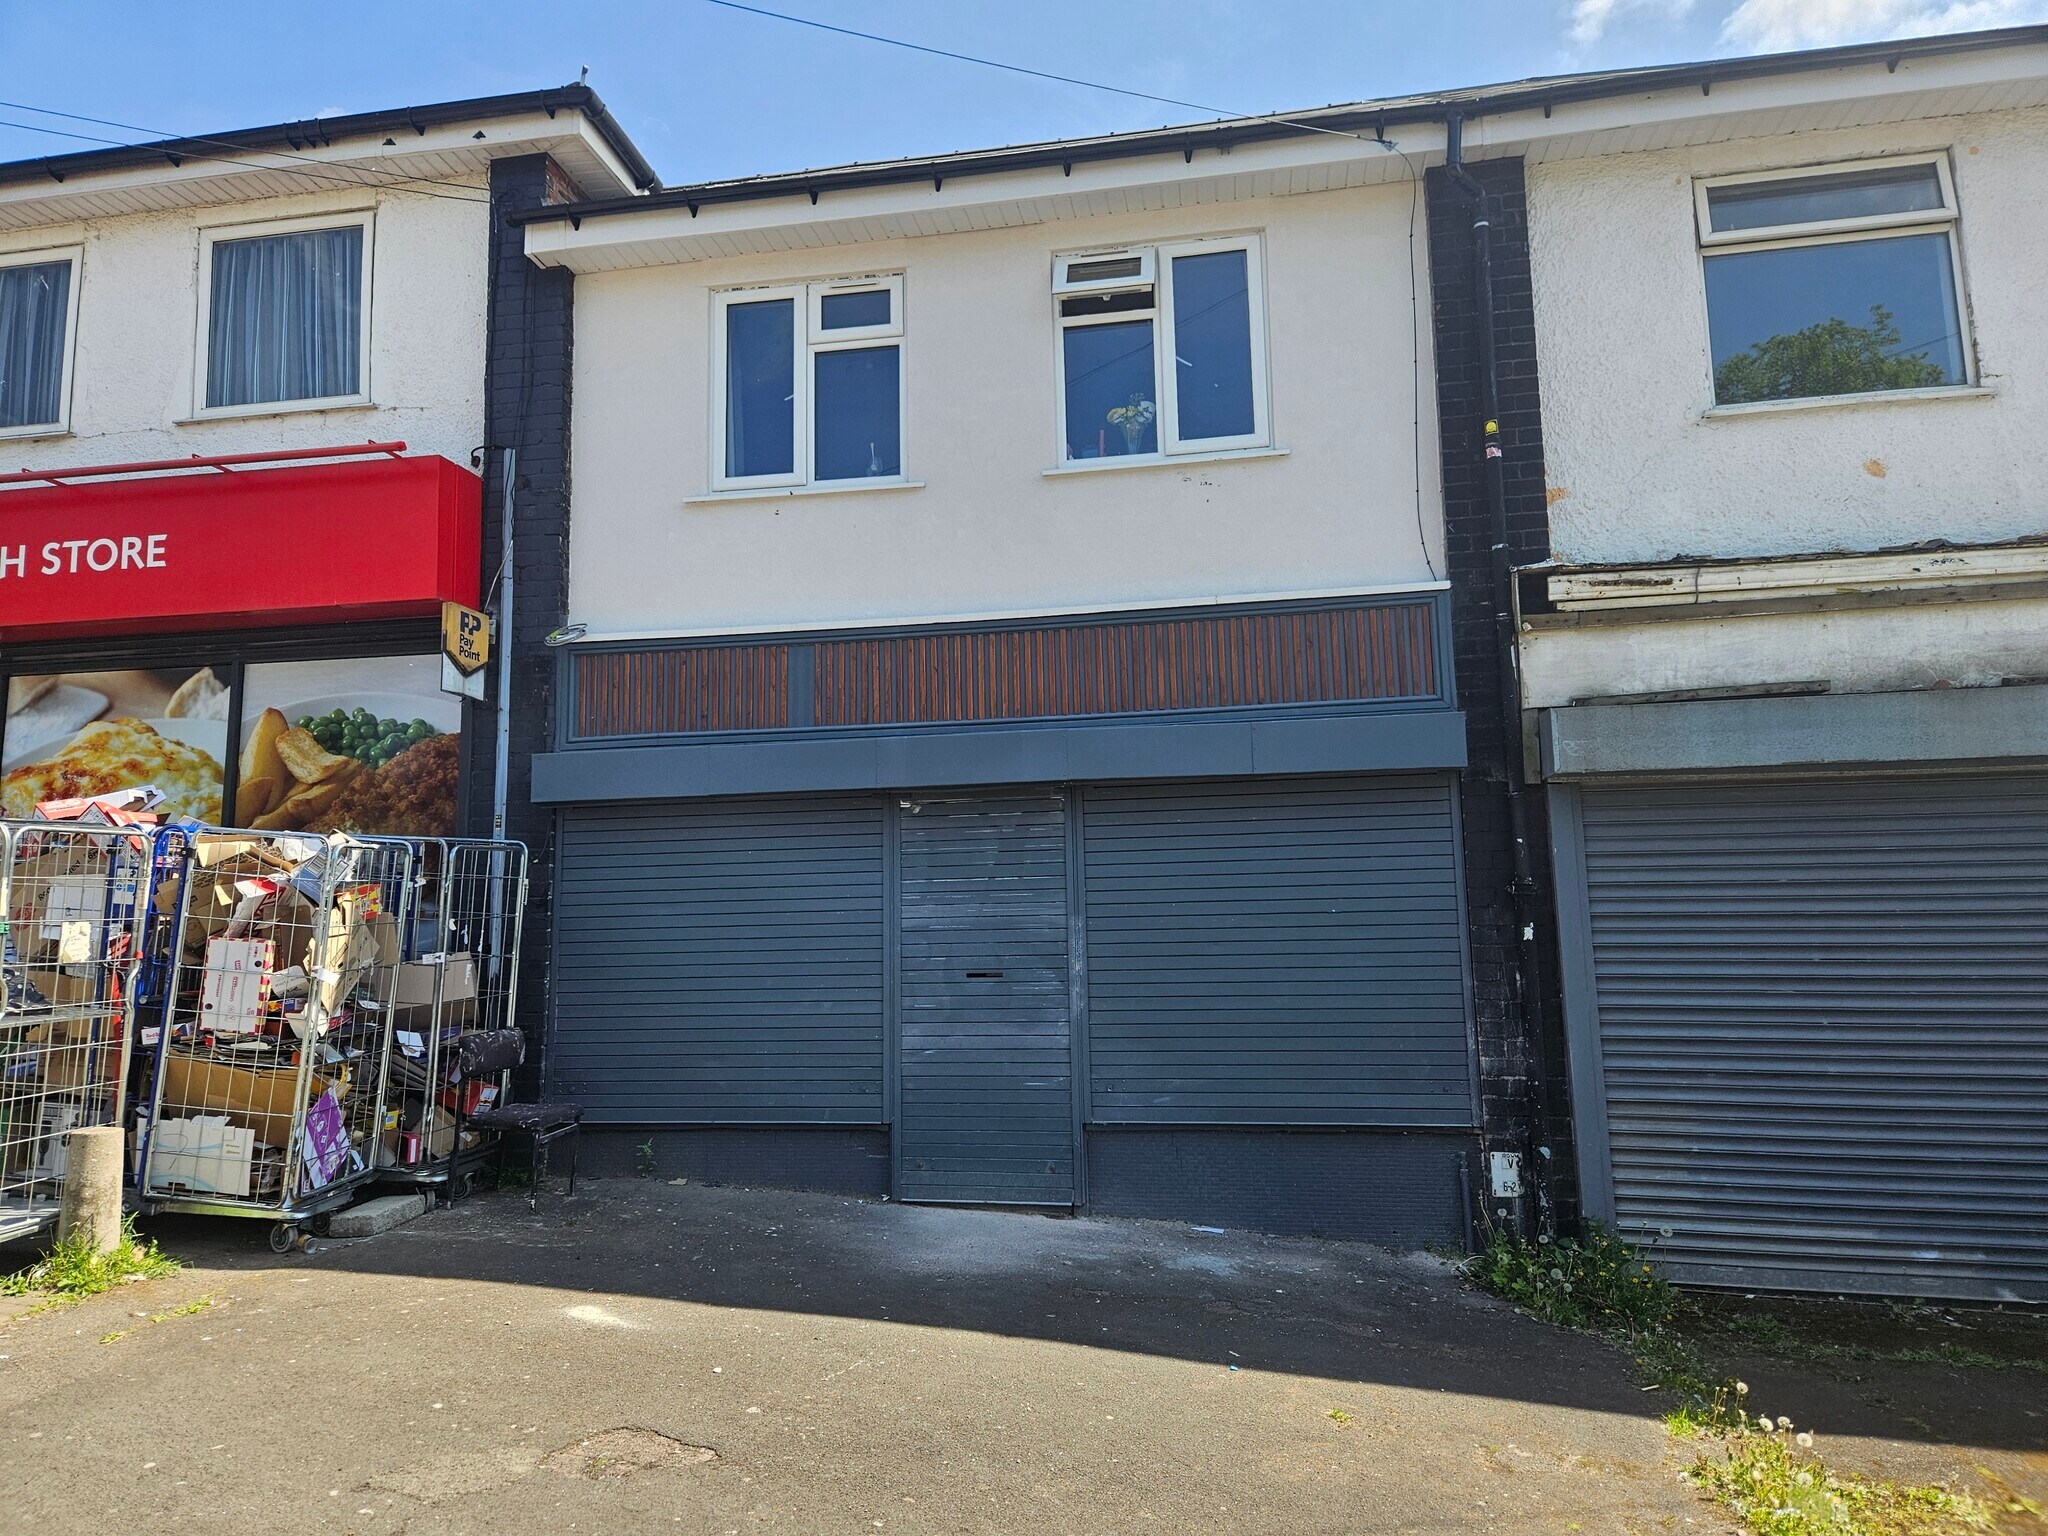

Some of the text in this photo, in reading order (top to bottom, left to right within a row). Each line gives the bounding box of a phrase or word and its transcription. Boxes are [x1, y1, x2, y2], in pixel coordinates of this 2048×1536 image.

[41, 534, 168, 575] STORE
[459, 633, 474, 650] Pay
[458, 645, 481, 662] Point
